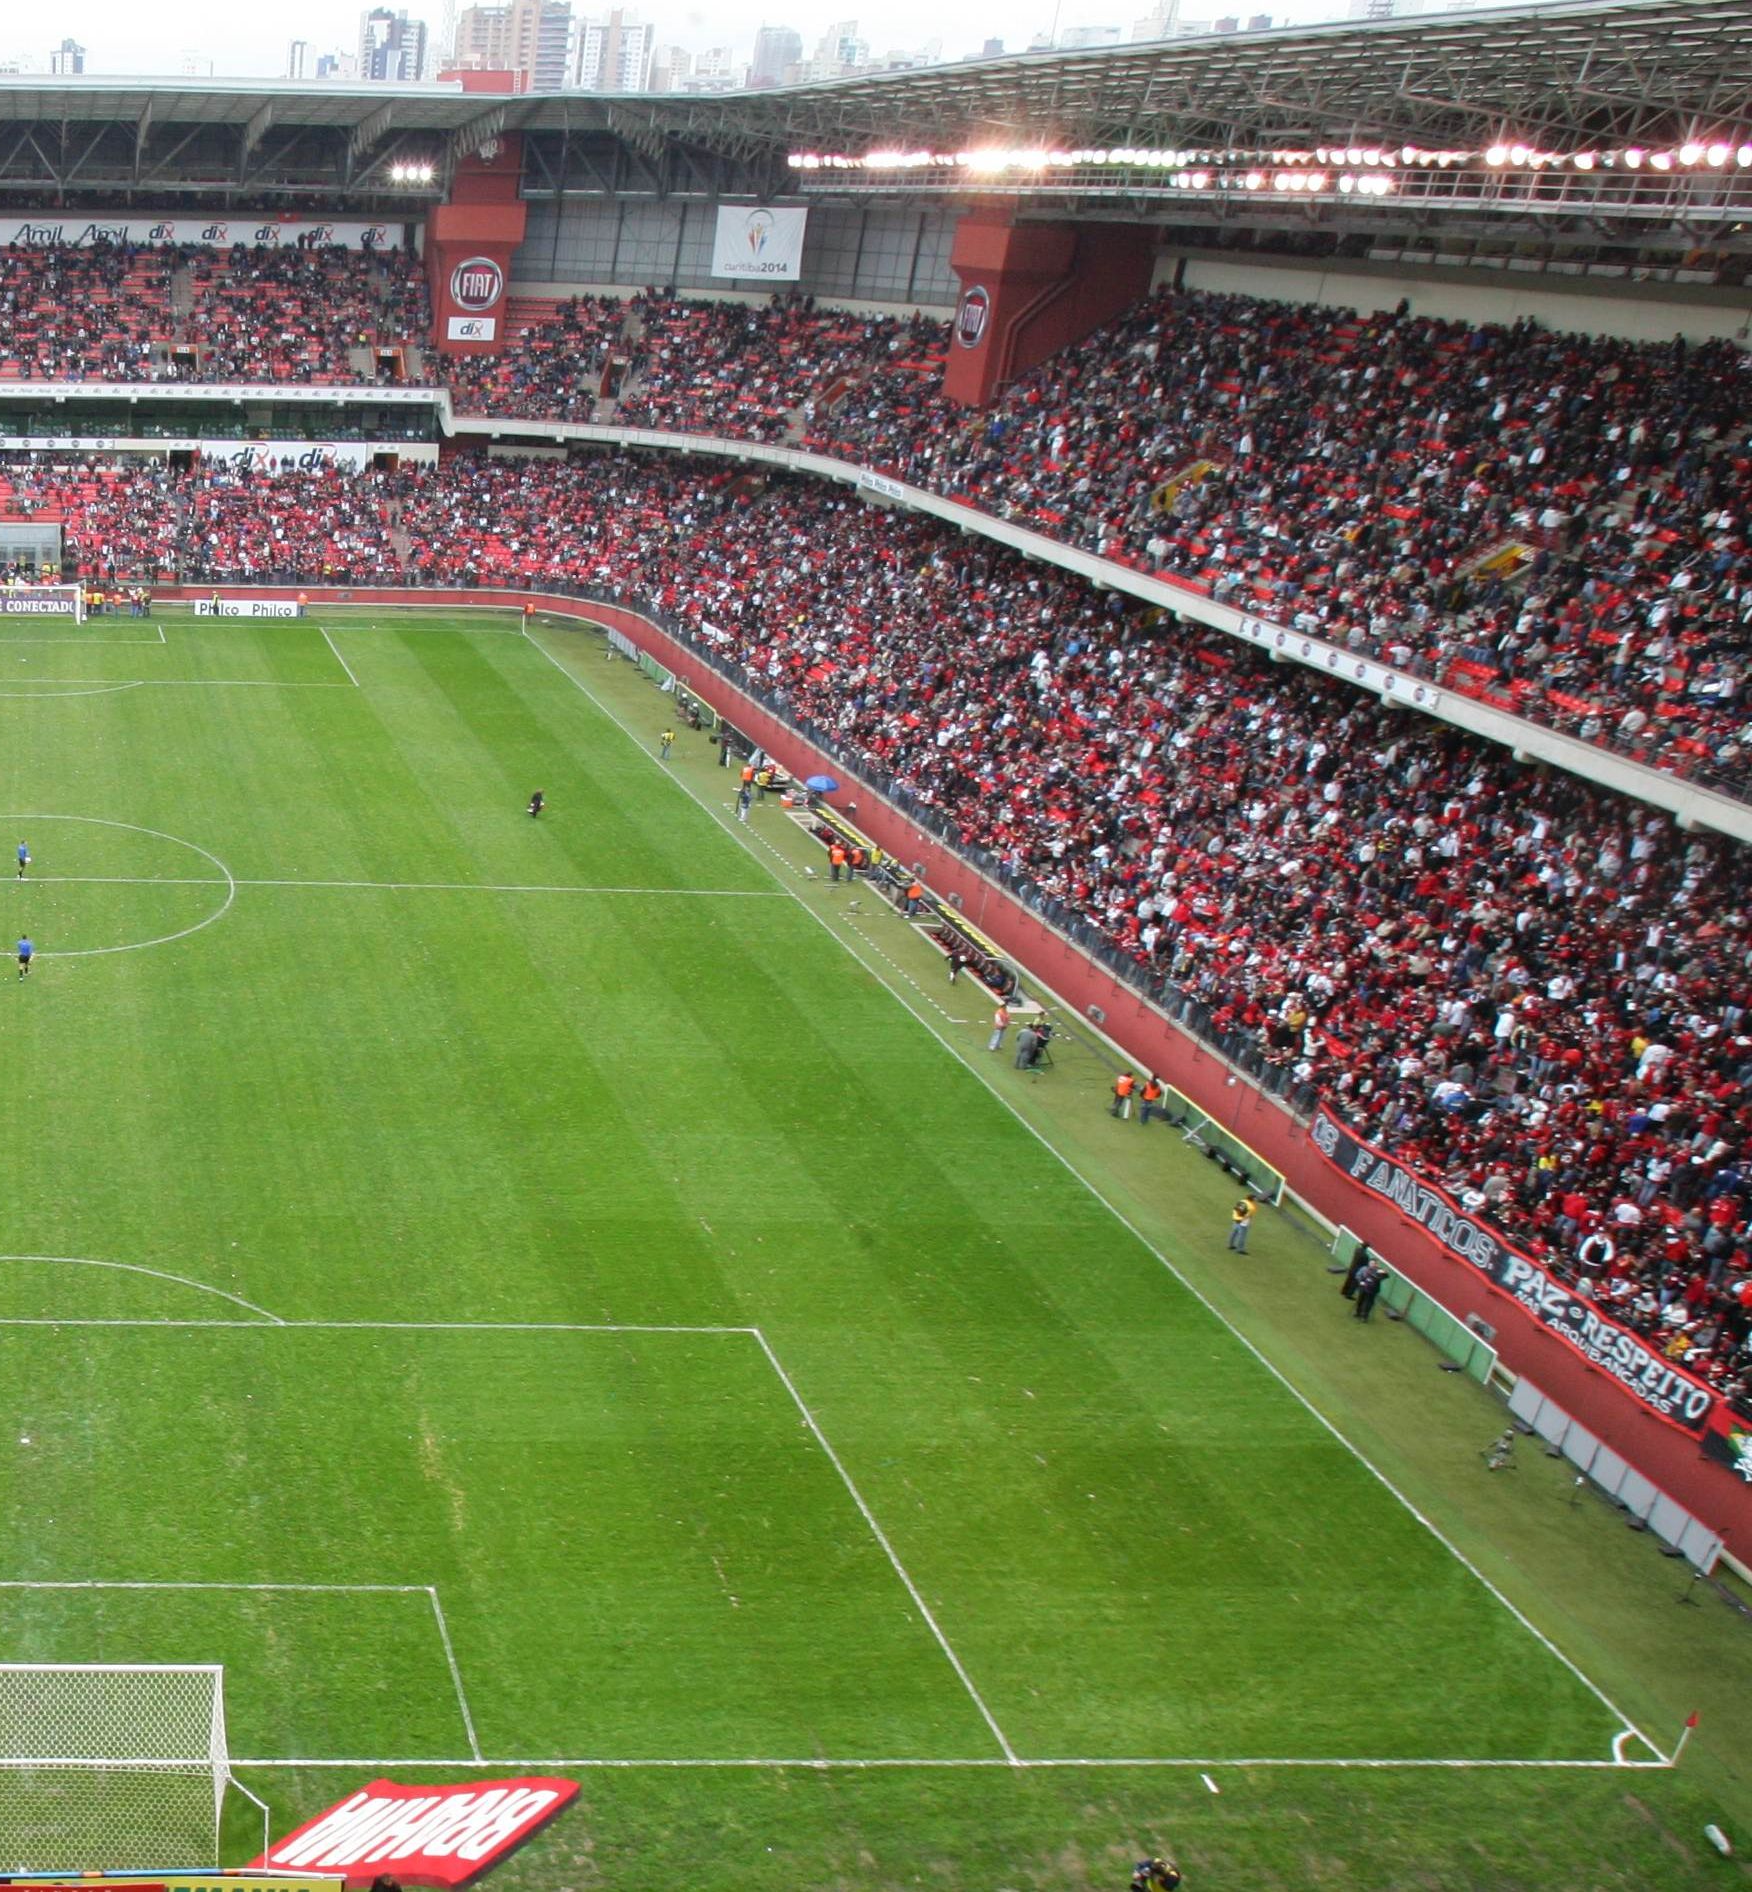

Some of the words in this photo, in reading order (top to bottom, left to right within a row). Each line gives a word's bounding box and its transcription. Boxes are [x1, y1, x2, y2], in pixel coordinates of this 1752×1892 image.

[14, 223, 63, 241] Amil
[148, 221, 175, 240] dix
[201, 222, 228, 241] dix
[254, 222, 281, 241] dix
[462, 273, 493, 297] FIAT
[253, 604, 292, 616] Philco
[1501, 1256, 1571, 1317] PAZ
[1580, 1310, 1711, 1419] RESPEITO
[1546, 1317, 1674, 1415] ARQUIBANCADAS
[272, 1790, 559, 1867] BRAHMA
